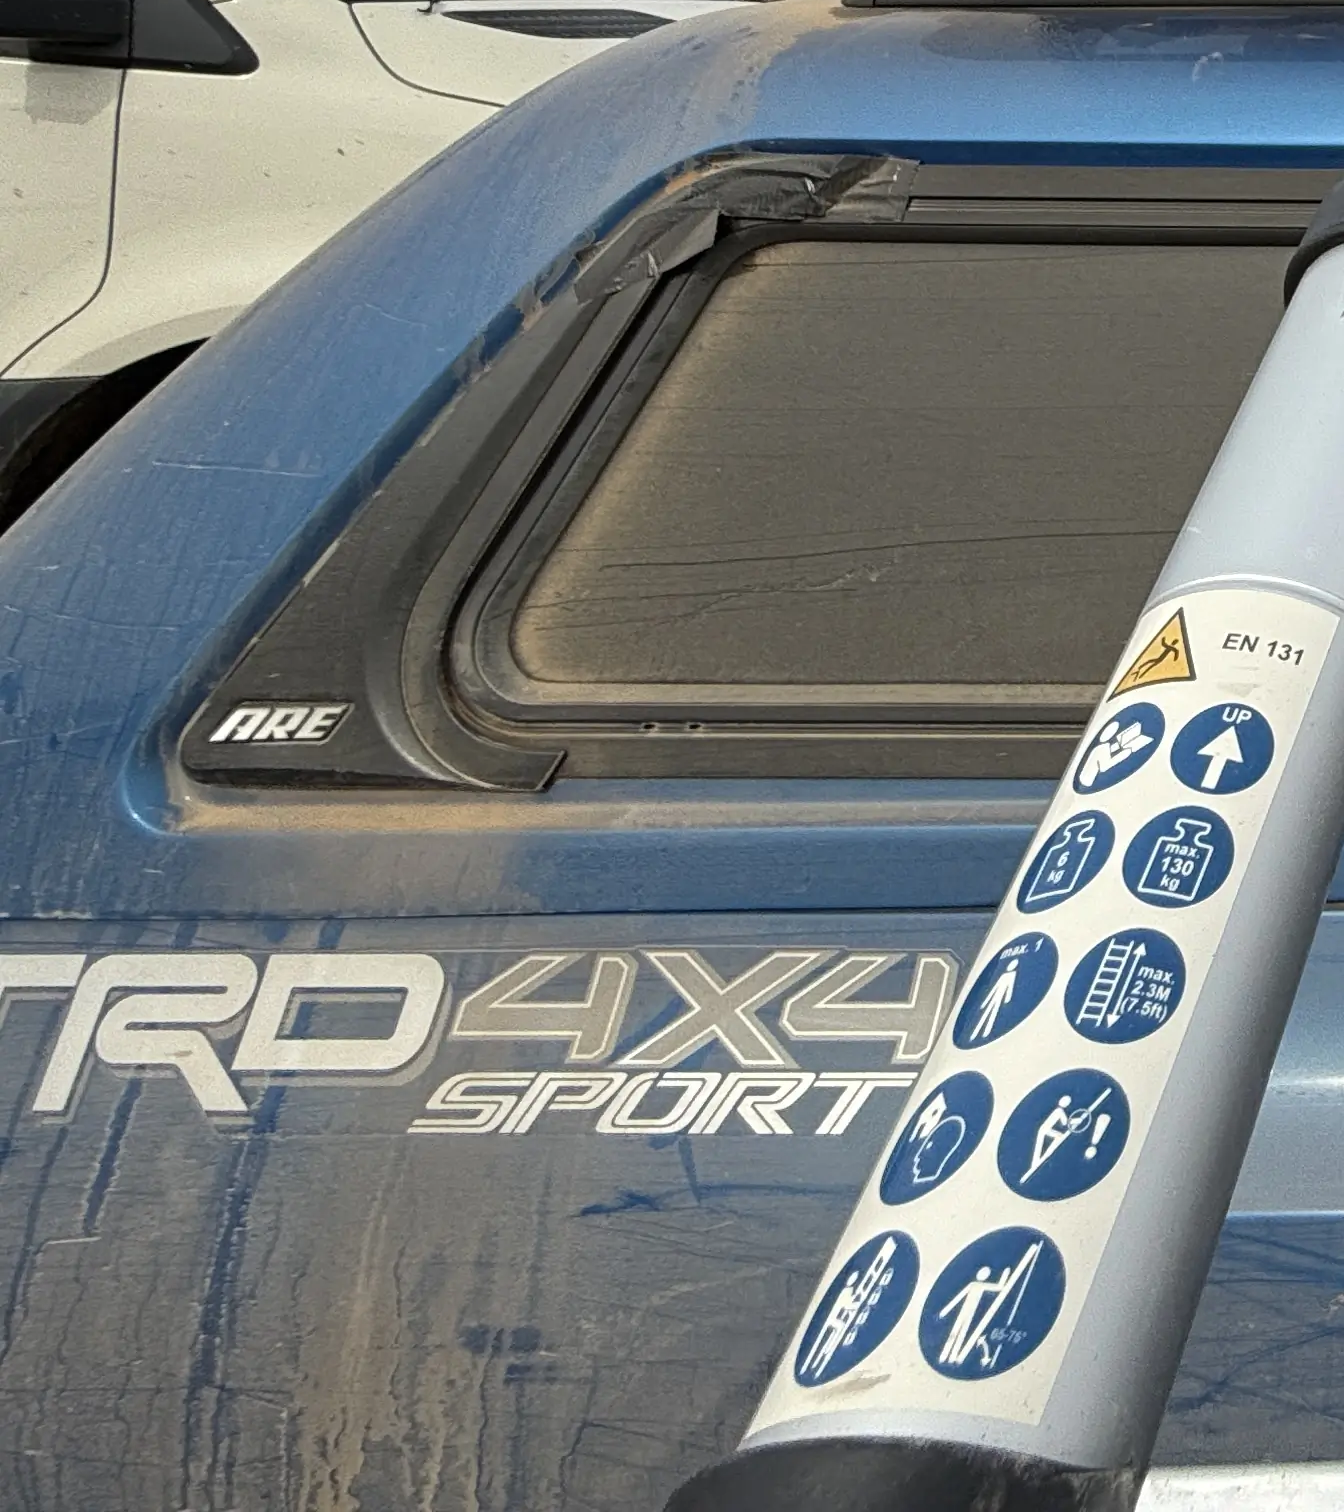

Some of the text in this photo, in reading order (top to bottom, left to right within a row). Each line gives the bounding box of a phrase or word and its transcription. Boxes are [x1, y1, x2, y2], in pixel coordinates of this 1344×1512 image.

[1222, 632, 1305, 666] EN 131
[208, 704, 349, 742] ARE
[1222, 706, 1252, 724] UP
[1057, 851, 1068, 868] 6
[1164, 842, 1200, 859] max.
[1047, 868, 1065, 883] kg
[1161, 857, 1195, 876] 130
[1160, 876, 1181, 891] kg
[1000, 937, 1045, 960] max. 1
[1138, 965, 1175, 986] max.
[1130, 979, 1172, 1002] 2.3M
[1120, 996, 1168, 1024] (7.5ft)
[0, 950, 954, 1112] TRD 4X4
[407, 1072, 919, 1134] SPORT
